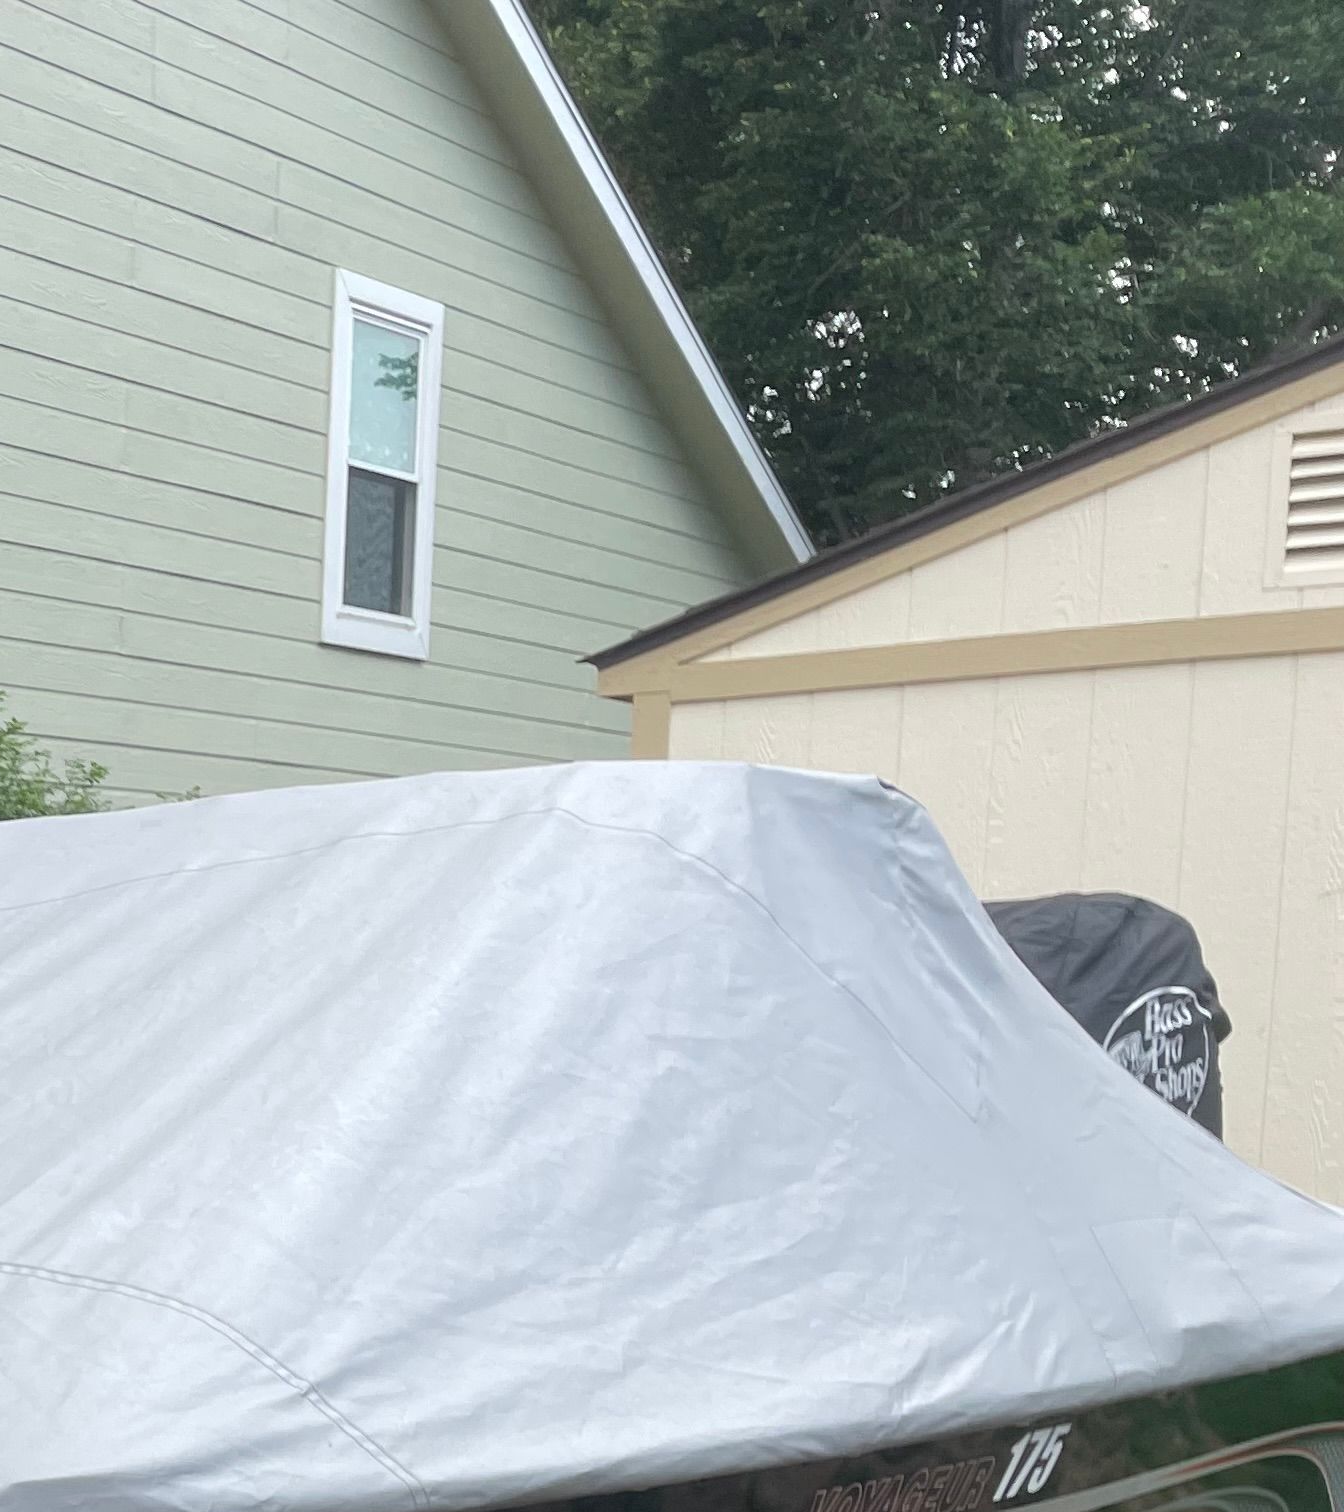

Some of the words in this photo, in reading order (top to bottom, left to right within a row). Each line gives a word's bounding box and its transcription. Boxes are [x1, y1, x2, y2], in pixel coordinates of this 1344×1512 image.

[1144, 997, 1193, 1041] Bass
[1151, 1032, 1184, 1074] Pro
[992, 1422, 1072, 1502] 175
